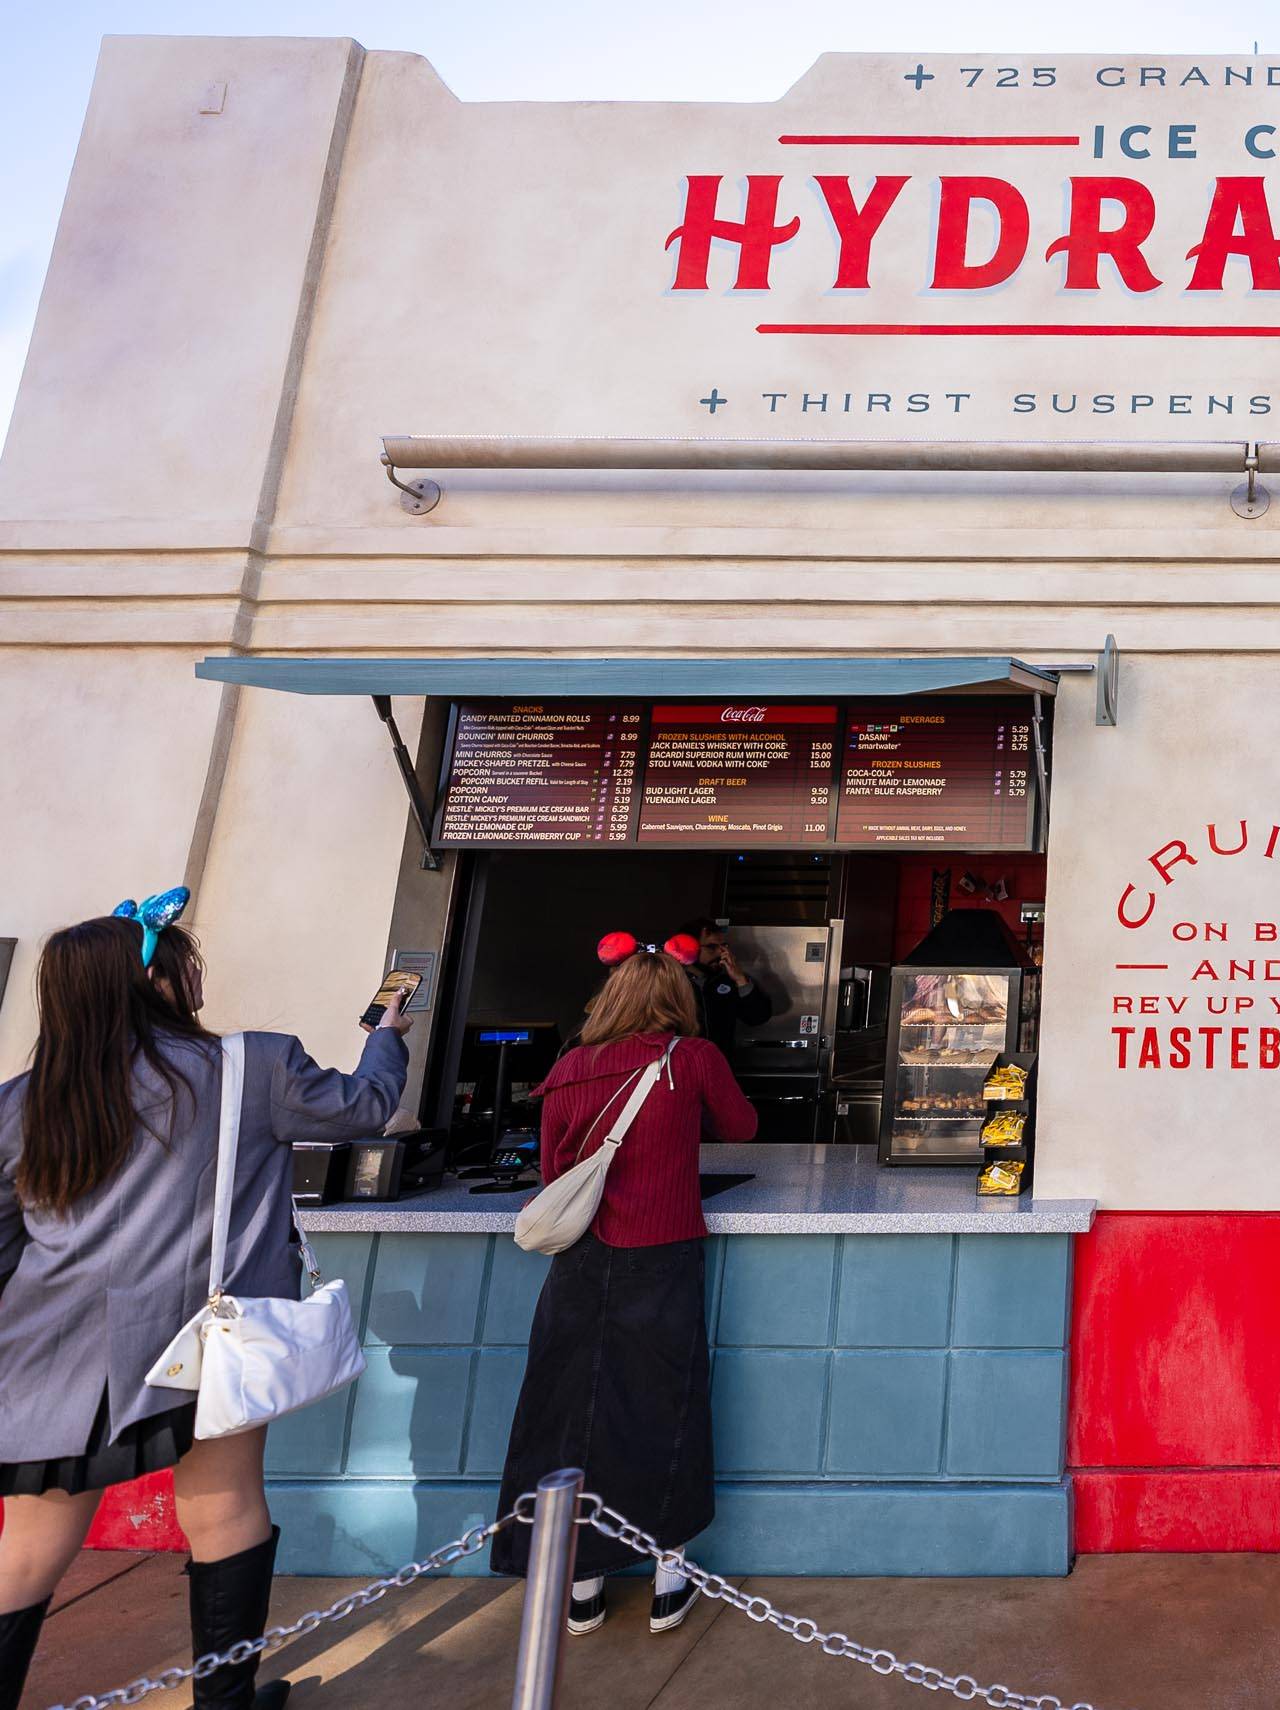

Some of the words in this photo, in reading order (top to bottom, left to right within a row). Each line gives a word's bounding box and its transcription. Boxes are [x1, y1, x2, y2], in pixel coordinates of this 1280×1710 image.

[959, 67, 1057, 88] 725
[1093, 124, 1197, 160] ICE
[762, 392, 971, 413] THIRST
[720, 707, 768, 722] Coca-Cola
[488, 715, 521, 723] PAINTED
[522, 715, 564, 723] CINNAMON
[566, 715, 591, 723] ROLLS
[622, 715, 640, 723] 8.99
[620, 733, 638, 741] 8.99
[658, 733, 688, 741] FROZEN
[650, 742, 672, 750] JACK
[672, 742, 705, 750] DANIEL'S
[685, 751, 724, 759] SUPERIOR
[725, 751, 745, 759] RUM
[619, 760, 635, 768] 7.79
[649, 760, 670, 768] STOLI
[672, 760, 695, 768] VANIL
[697, 760, 724, 768] VODKA
[725, 760, 746, 768] WITH
[646, 787, 663, 795] BUD
[664, 787, 687, 795] LIGHT
[444, 823, 474, 831] FROZEN
[475, 823, 517, 831] LEMONADE
[518, 823, 533, 831] CUP
[1172, 921, 1228, 941] ON
[1113, 996, 1188, 1014] REV
[1207, 996, 1254, 1014] UP
